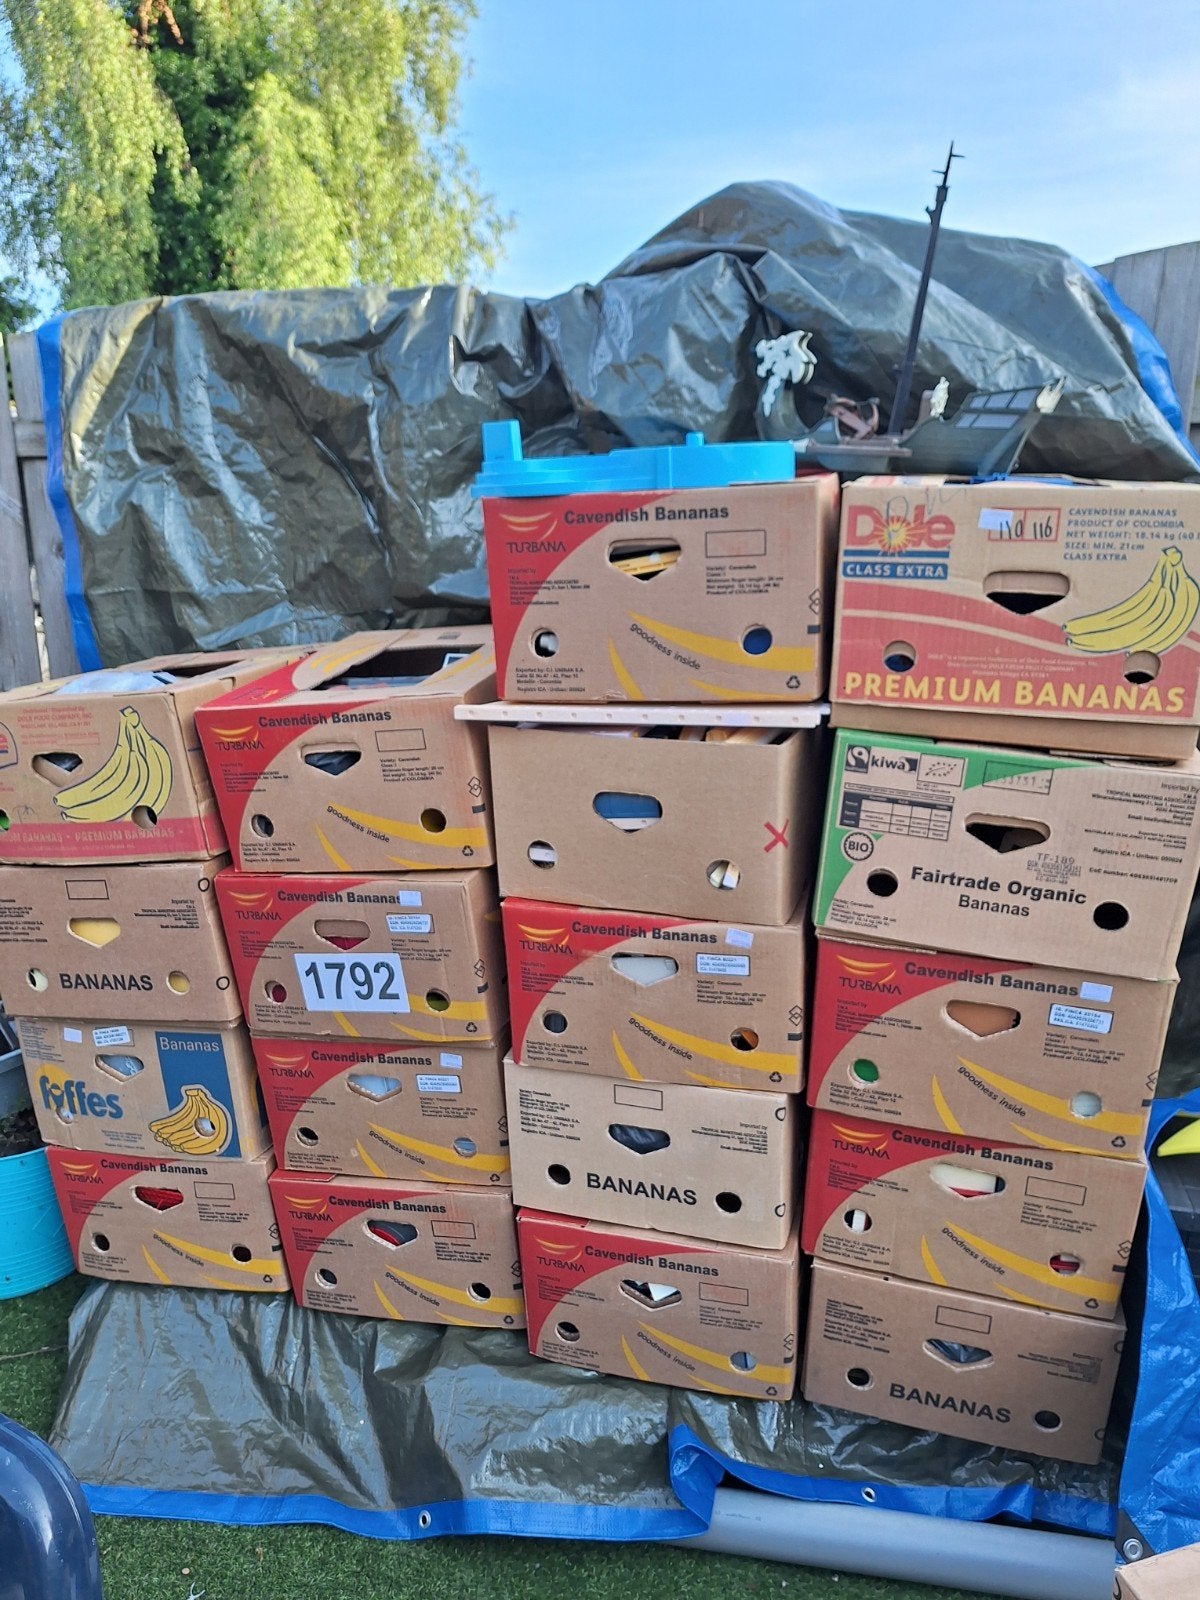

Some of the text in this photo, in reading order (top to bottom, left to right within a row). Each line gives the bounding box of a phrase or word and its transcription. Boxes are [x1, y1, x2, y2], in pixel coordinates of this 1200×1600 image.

[564, 505, 729, 525] Cavendish Bananas
[1069, 508, 1177, 517] CAVENDISH BANANAS
[1067, 519, 1185, 528] PRODUCT OF COLOMBIA
[1164, 532, 1175, 540] kg
[506, 541, 567, 554] TURBANA
[1063, 552, 1127, 561] CLASS EXTRA
[846, 564, 945, 577] CLASS EXTRA
[630, 622, 701, 671] goodness inside
[844, 672, 1185, 713] PREMIUM BANANAS
[258, 709, 392, 729] Cavendish Bananas
[215, 739, 264, 751] TURBANA
[871, 755, 906, 771] kiwa
[326, 805, 390, 843] goodness inside
[848, 840, 869, 853] BIO
[910, 865, 1001, 893] Fairtrade
[1007, 880, 1088, 906] Organic
[277, 890, 401, 905] Cavendish Bananas
[958, 894, 1030, 918] Bananas
[235, 910, 281, 921] TURBANA
[572, 921, 717, 944] Cavendish Bananas
[519, 940, 573, 955] TURBANA
[59, 972, 154, 991] BANANAS
[304, 961, 400, 1001] 1792
[839, 977, 902, 996] TURBANA
[904, 961, 1079, 997] Cavendish Bananas
[159, 1037, 220, 1053] Bananas
[628, 1016, 693, 1060] goodness inside
[311, 1050, 432, 1066] Cavendish Bananas
[269, 1068, 314, 1079] TURBANA
[957, 1065, 1027, 1118] goodness inside
[368, 1130, 426, 1166] goodness inside
[832, 1138, 890, 1160] TURBANA
[891, 1128, 1054, 1171] Cavendish Bananas
[101, 1159, 208, 1176] Cavendish Bananas
[586, 1172, 698, 1206] BANANAS
[328, 1195, 446, 1214] Cavendish Bananas
[288, 1210, 334, 1222] TURBANA
[153, 1234, 204, 1267] goodness inside
[941, 1227, 1005, 1275] goodness inside
[536, 1256, 585, 1273] TURBANA
[585, 1245, 719, 1277] Cavendish Bananas
[384, 1271, 440, 1307] goodness inside
[637, 1331, 696, 1372] goodness inside
[888, 1382, 1011, 1424] BANANAS
